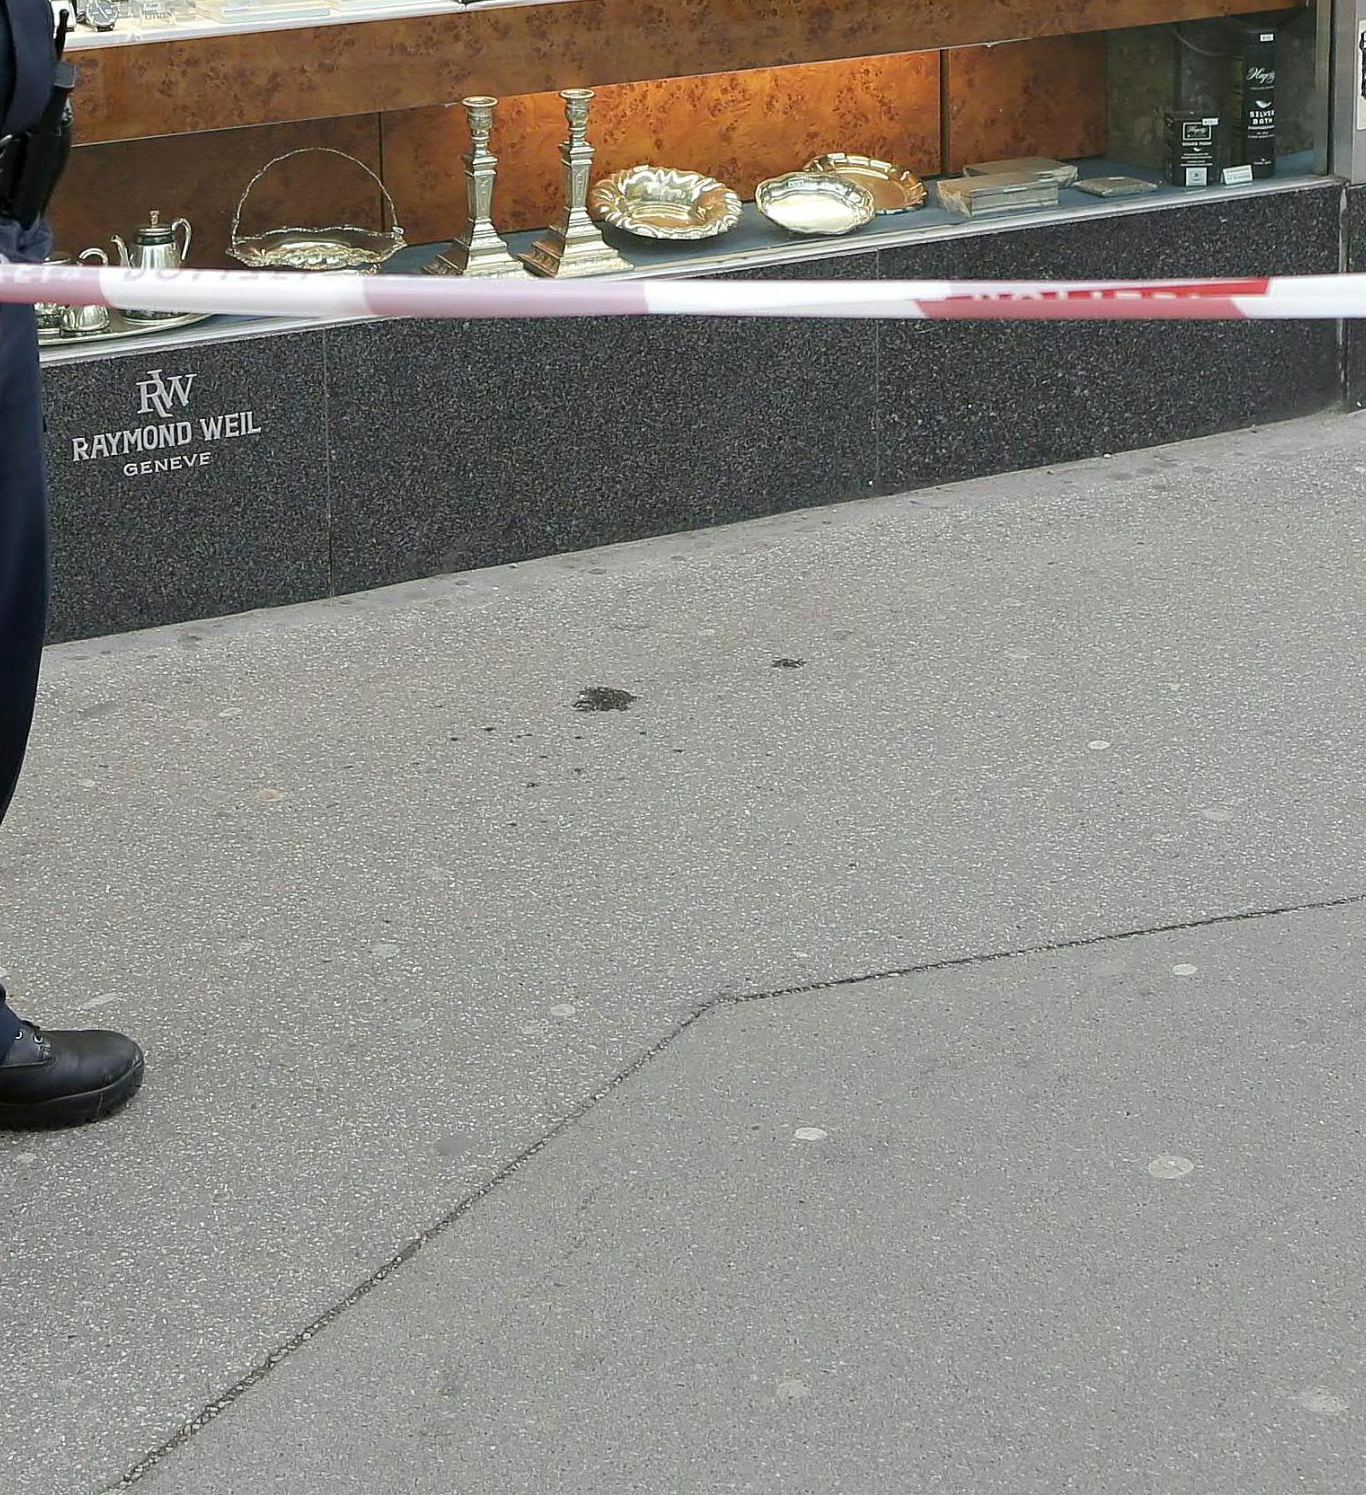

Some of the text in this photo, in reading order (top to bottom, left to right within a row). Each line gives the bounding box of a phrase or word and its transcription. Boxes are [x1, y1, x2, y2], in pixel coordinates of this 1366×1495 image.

[72, 410, 262, 462] RAYMOND WEIL
[122, 451, 212, 477] GENEVE
